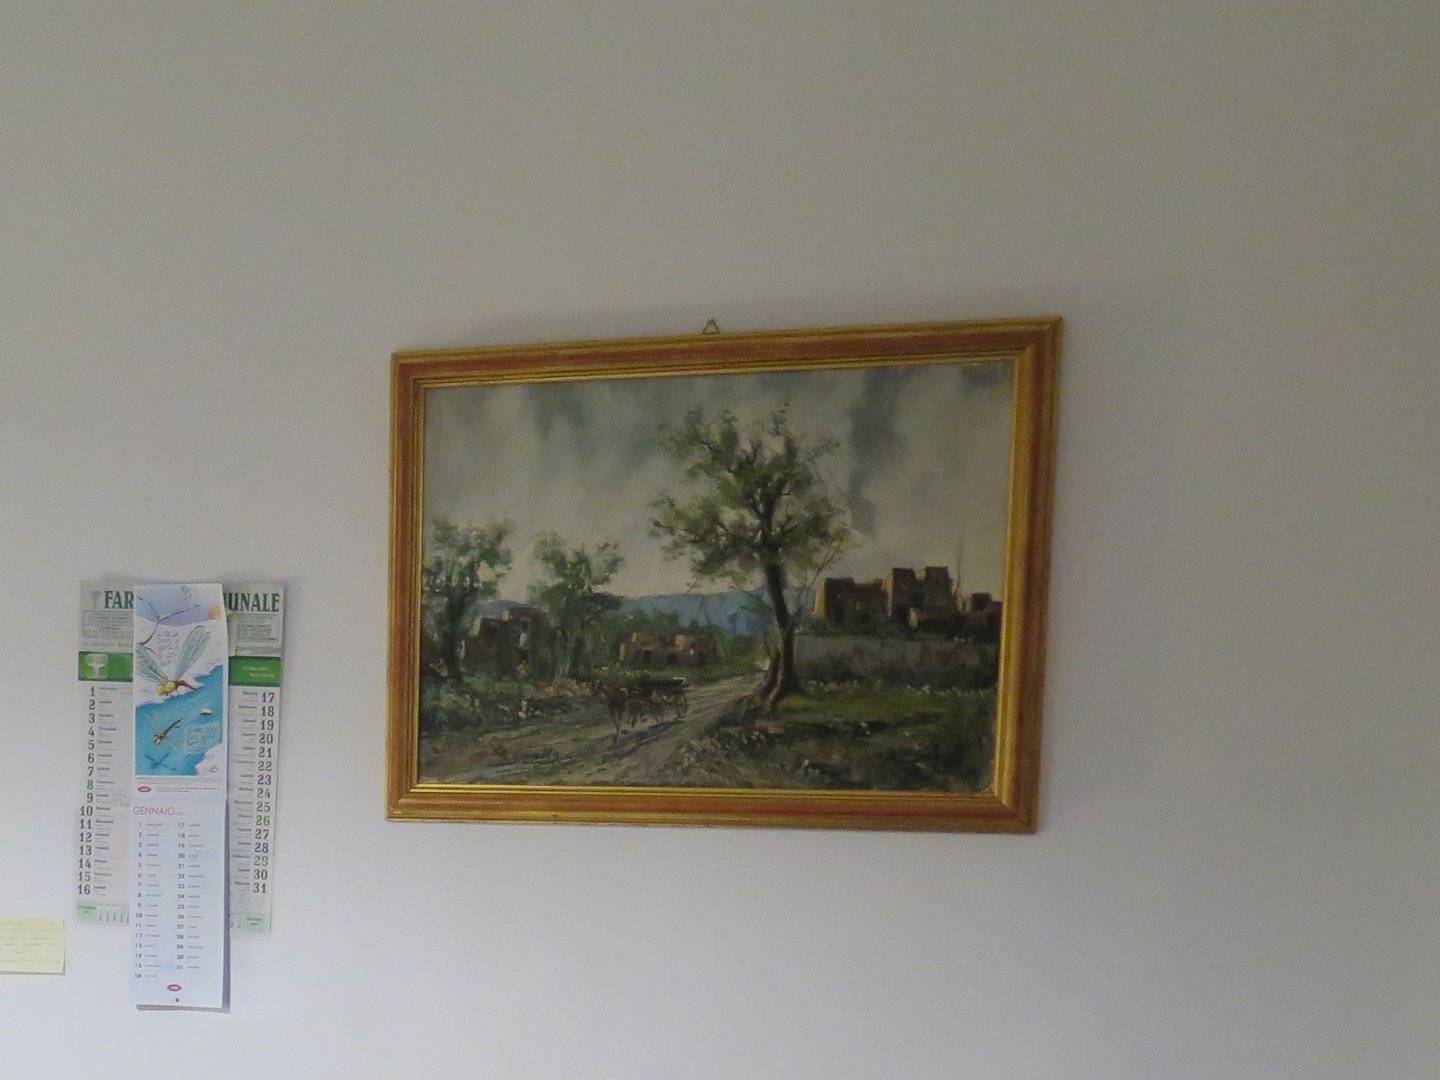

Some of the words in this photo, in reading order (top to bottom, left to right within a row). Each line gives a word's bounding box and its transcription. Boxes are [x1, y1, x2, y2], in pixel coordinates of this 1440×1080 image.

[224, 592, 280, 612] UNALE
[90, 687, 95, 696] 1
[262, 692, 275, 703] 17
[89, 699, 95, 710] 2
[261, 706, 274, 717] 18
[89, 713, 95, 723] 3
[261, 720, 274, 730] 19
[88, 727, 95, 737] 4
[259, 733, 273, 744] 20
[88, 740, 95, 750] 5
[259, 747, 272, 758] 21
[88, 753, 94, 763] 6
[258, 761, 272, 771] 22
[88, 766, 94, 777] 7
[87, 779, 93, 790] 8
[257, 774, 271, 785] 23
[87, 793, 93, 803] 9
[257, 788, 270, 798] 24
[80, 806, 93, 816] 10
[133, 807, 175, 816] GENNAIO
[256, 801, 270, 812] 25
[80, 819, 92, 829] 11
[256, 815, 270, 826] 26
[80, 832, 92, 842] 12
[255, 829, 269, 839] 27
[79, 845, 91, 855] 13
[255, 842, 269, 853] 28
[79, 858, 91, 868] 14
[254, 855, 268, 866] 29
[78, 871, 91, 881] 15
[254, 869, 267, 880] 30
[78, 884, 90, 895] 16
[253, 883, 266, 893] 31
